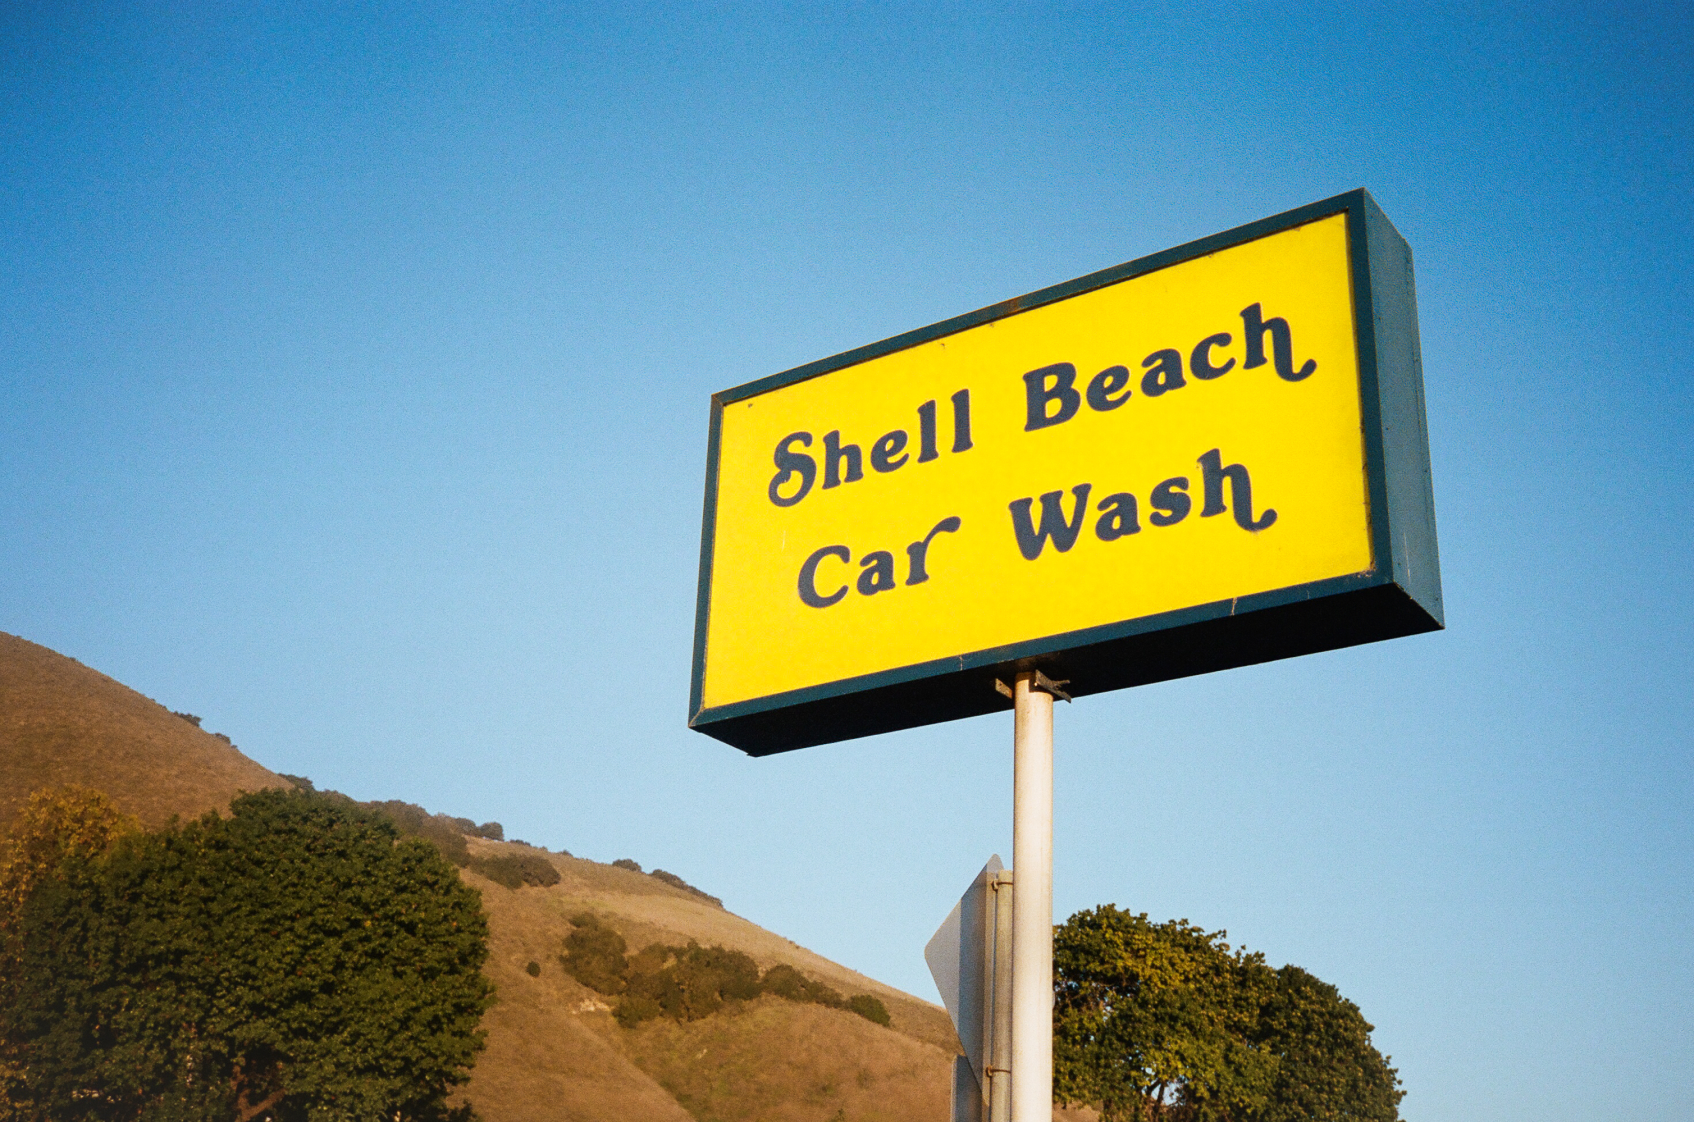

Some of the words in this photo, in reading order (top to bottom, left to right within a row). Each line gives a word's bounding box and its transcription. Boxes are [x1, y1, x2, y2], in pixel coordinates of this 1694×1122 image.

[768, 389, 974, 507] Shell
[1022, 302, 1317, 432] Beach
[797, 516, 961, 608] Car
[1008, 448, 1278, 561] Wash
